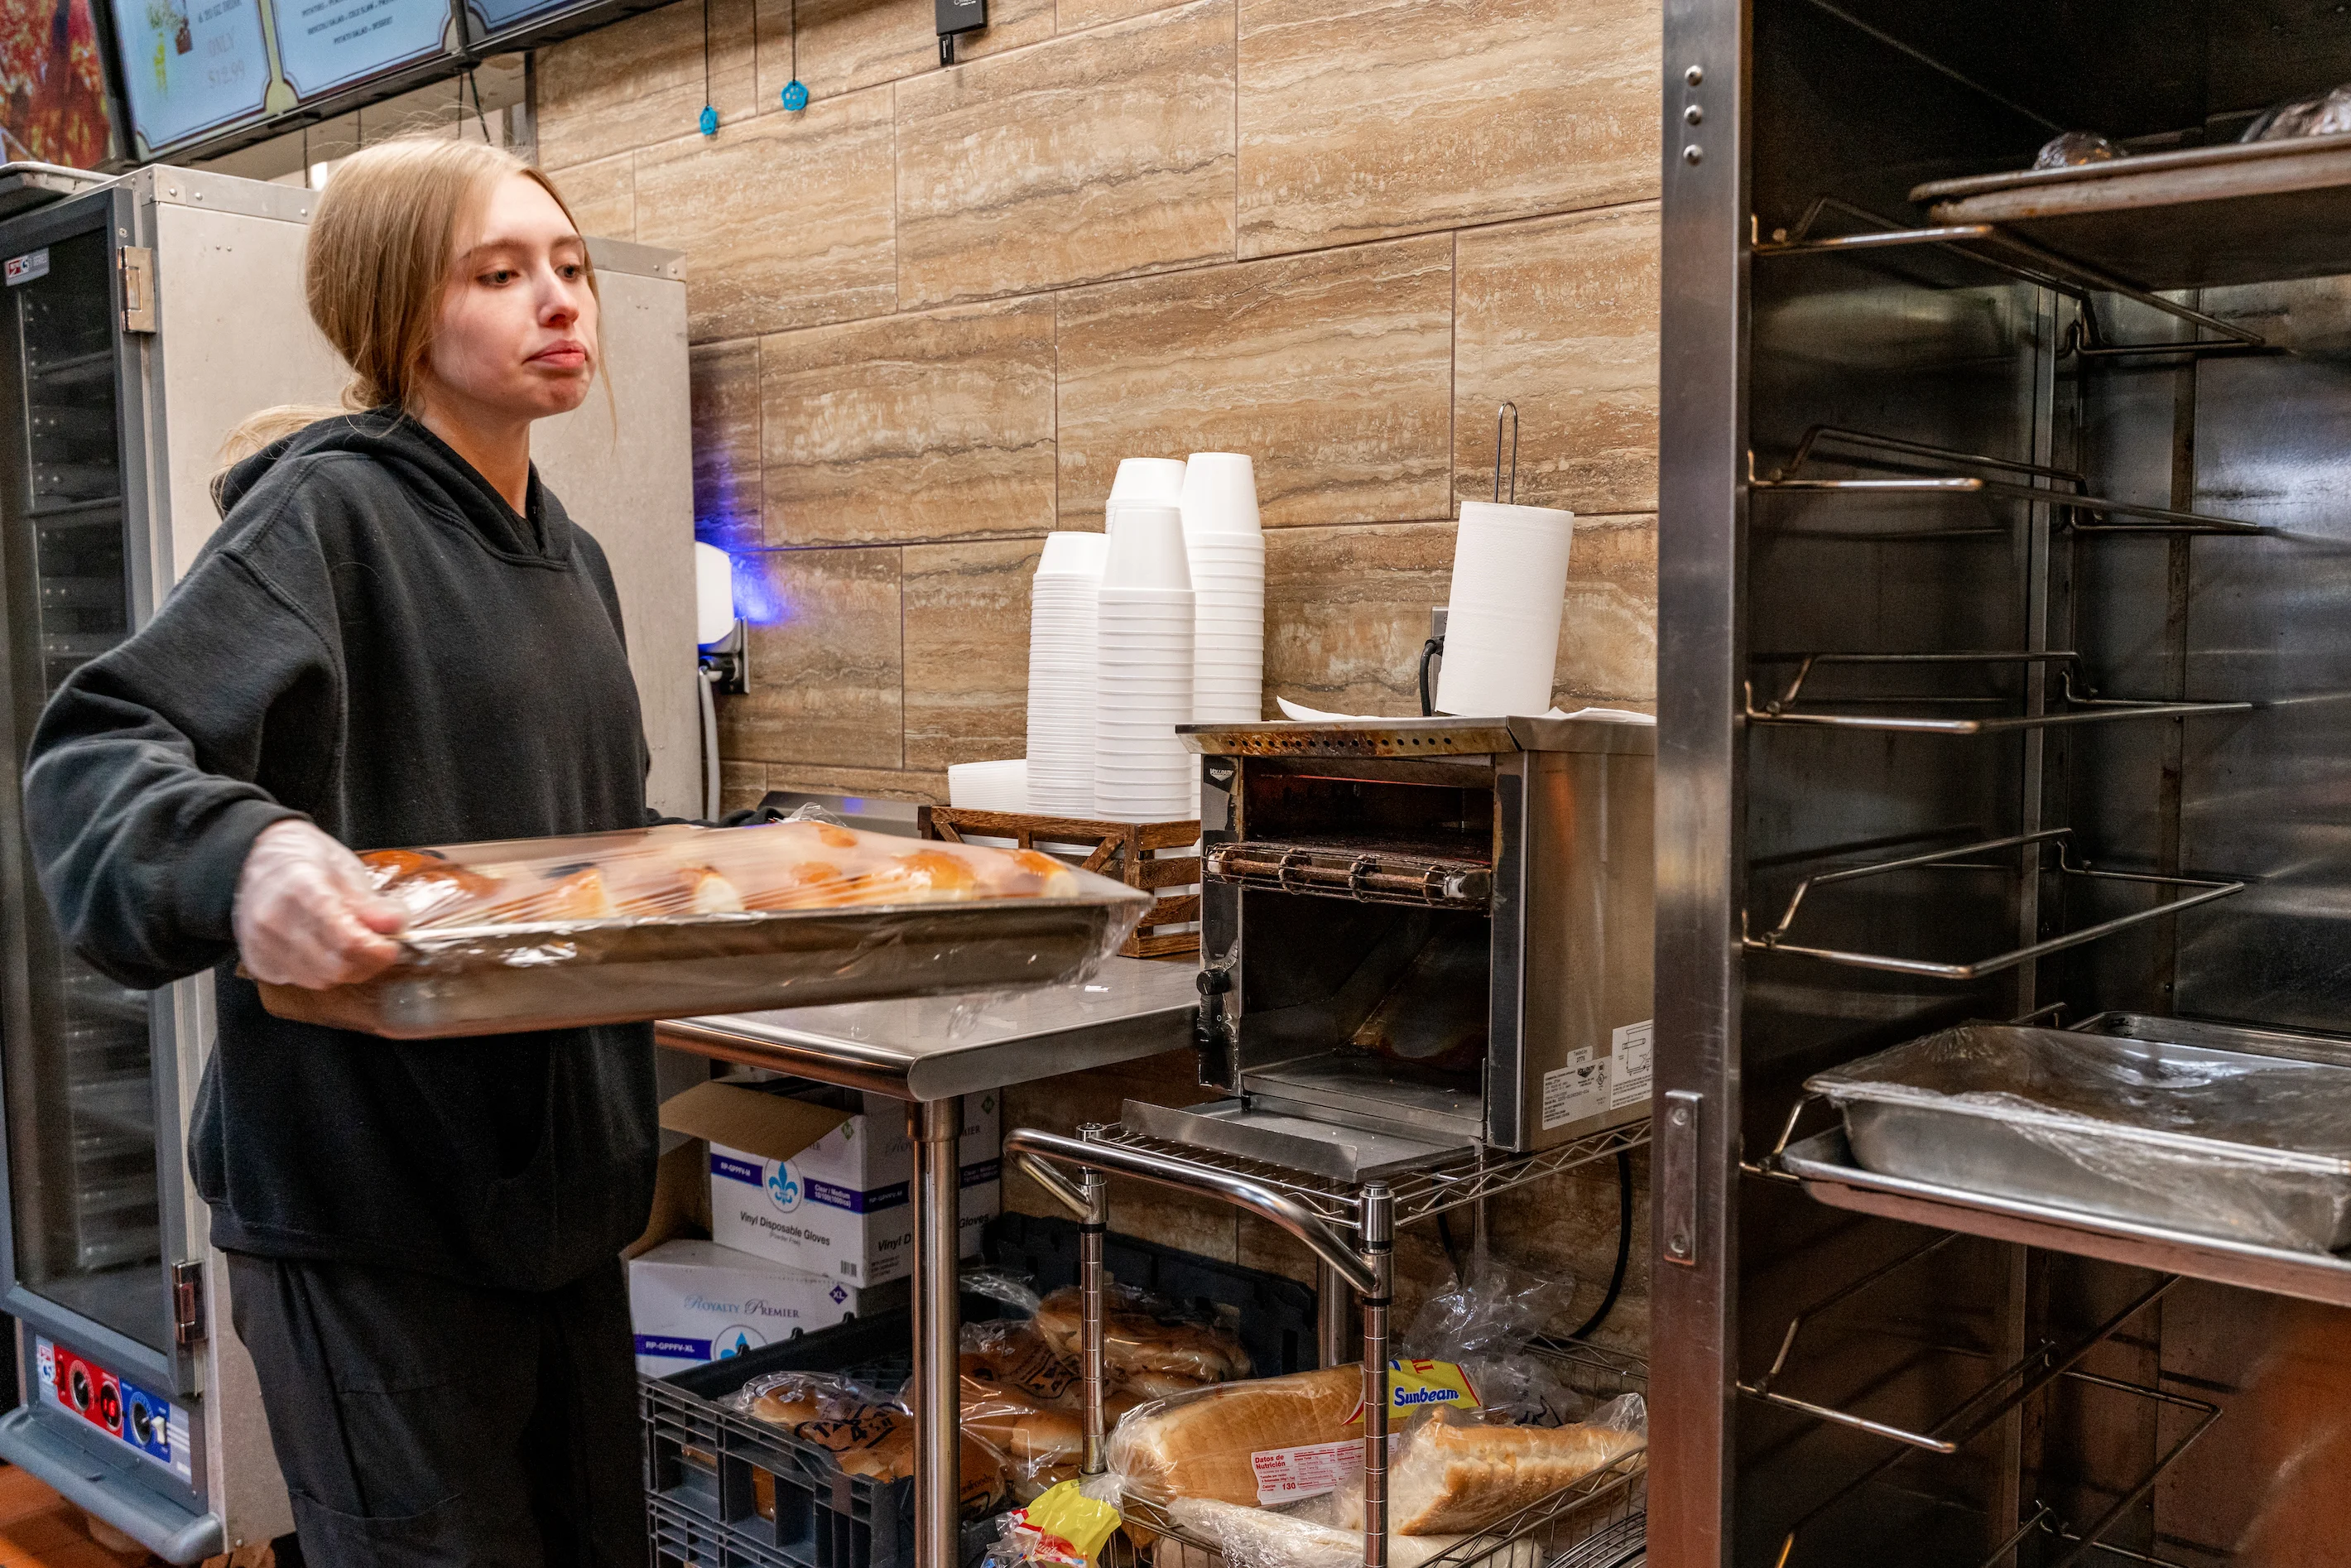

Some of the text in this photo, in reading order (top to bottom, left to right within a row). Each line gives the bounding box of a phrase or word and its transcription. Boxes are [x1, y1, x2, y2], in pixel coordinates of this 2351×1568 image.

[831, 1188, 851, 1200] Medium
[959, 1214, 989, 1229] Gloves
[740, 1211, 830, 1246] Vinyl Disposable Gloves
[878, 1235, 902, 1252] Vinyl
[832, 1290, 845, 1301] XL
[1394, 1386, 1459, 1407] Sunbeam
[1256, 1461, 1286, 1469] Nutrición
[1282, 1482, 1296, 1490] 130
